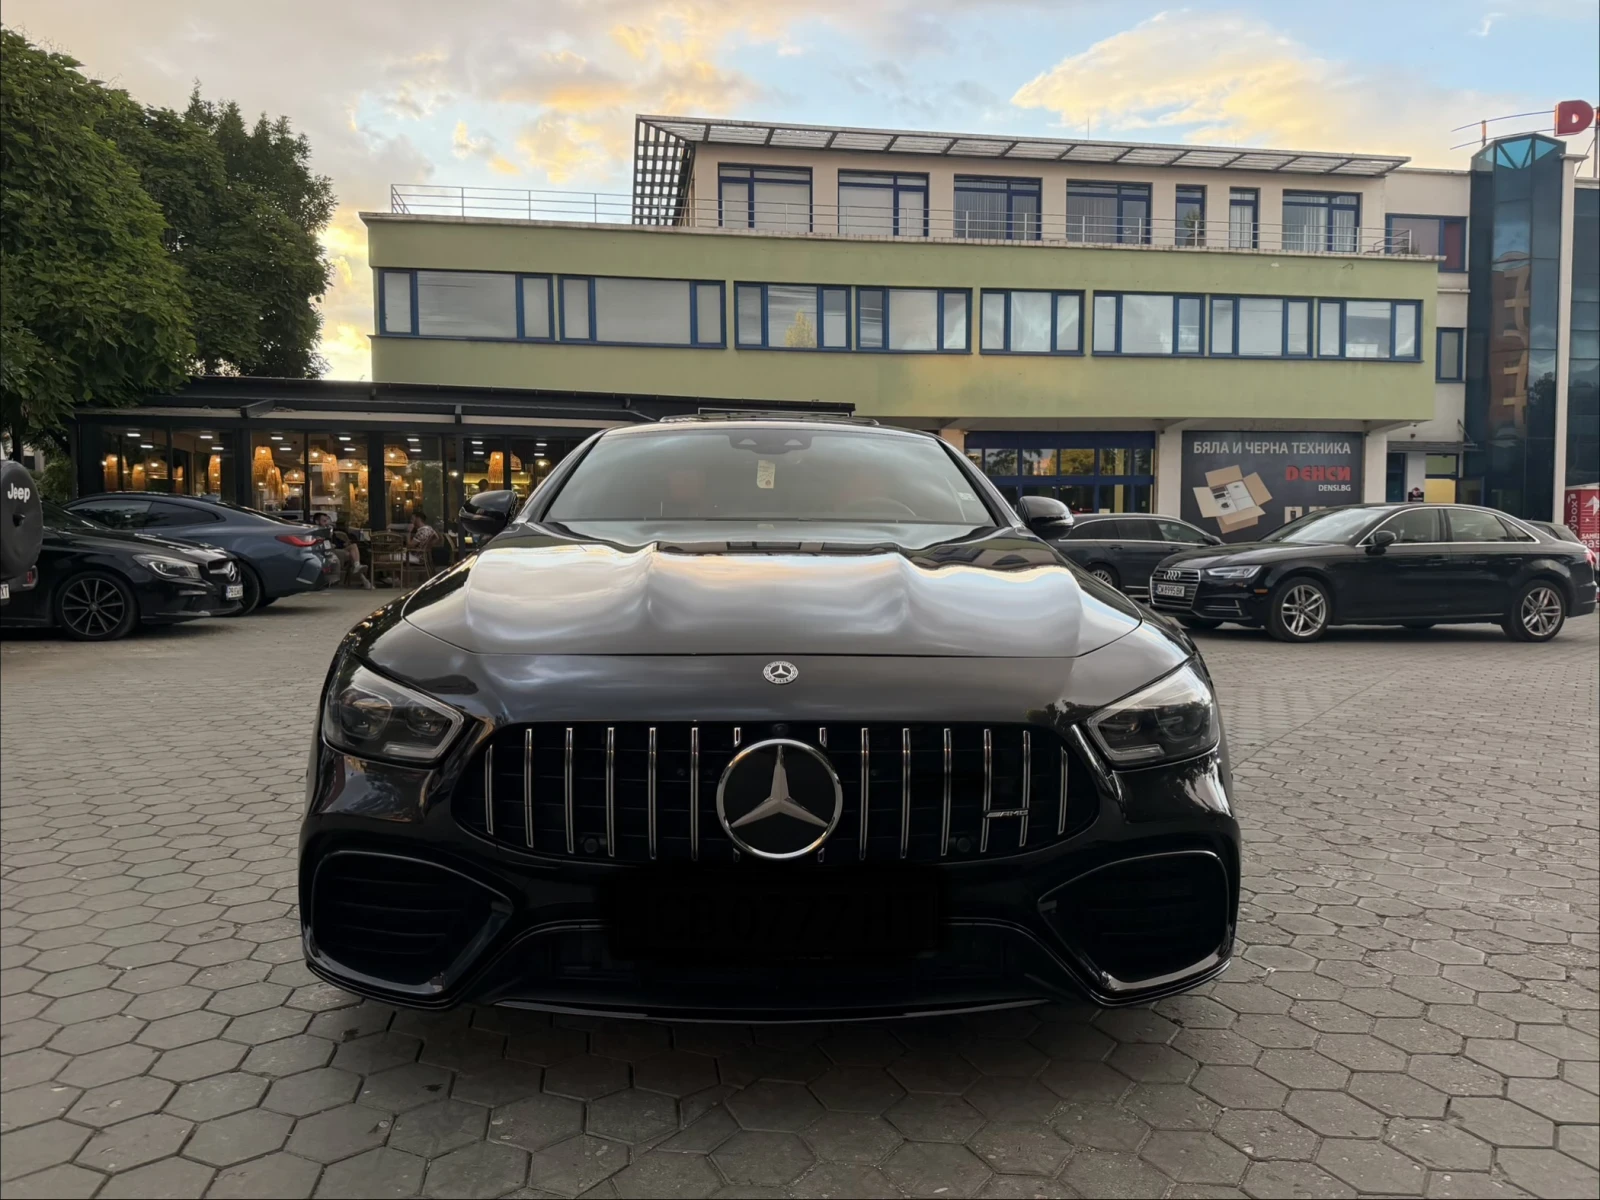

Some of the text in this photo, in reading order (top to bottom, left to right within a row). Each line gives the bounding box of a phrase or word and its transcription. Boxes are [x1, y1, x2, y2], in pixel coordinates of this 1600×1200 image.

[1193, 441, 1352, 454] БЯЛА И ЧЕРНА ТЕХНИКА
[7, 482, 31, 503] Jeep
[1318, 484, 1352, 492] DENSI.BG
